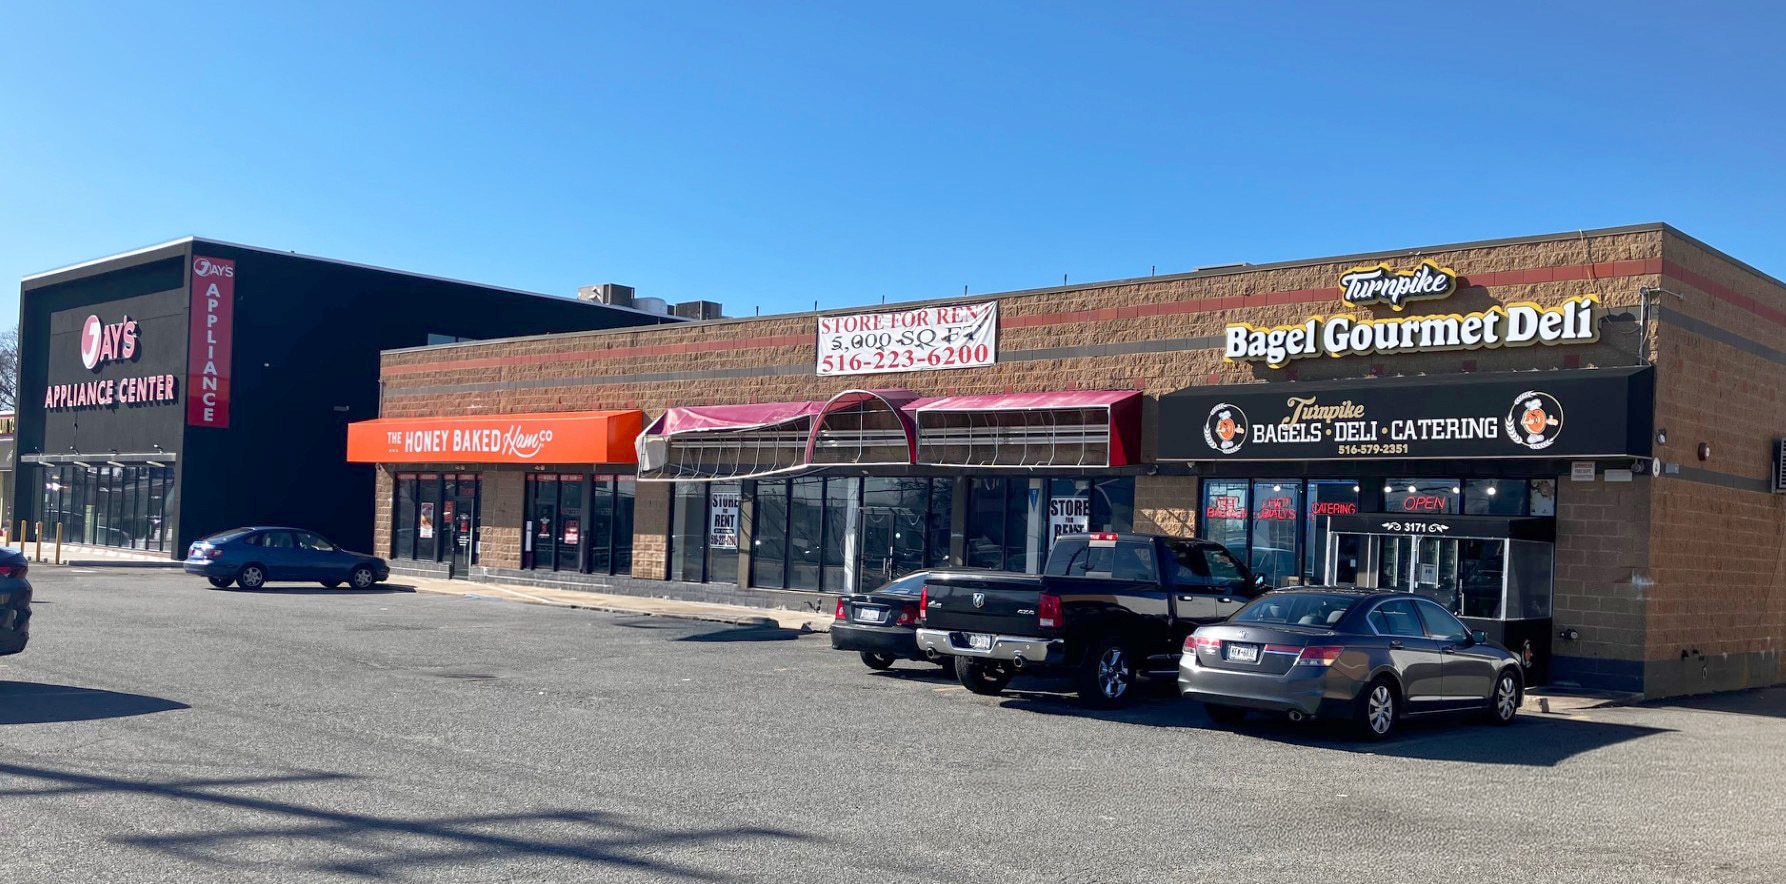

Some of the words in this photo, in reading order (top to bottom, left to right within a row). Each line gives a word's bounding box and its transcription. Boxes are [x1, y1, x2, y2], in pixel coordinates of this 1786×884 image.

[1341, 263, 1449, 304] Turnpike
[821, 315, 884, 334] STORE
[891, 308, 930, 329] FOR
[1225, 318, 1317, 364] Bagel
[1322, 309, 1499, 354] Gourmet
[1505, 297, 1594, 344] Deli
[202, 283, 220, 422] APPLIANCE
[822, 343, 988, 373] 516-223-6200
[44, 381, 114, 408] APPLIANCE
[118, 374, 175, 404] CENTER
[1282, 396, 1366, 431] Turnpike
[387, 432, 402, 444] THE
[405, 430, 449, 453] HONEY
[453, 429, 501, 453] BAKED
[501, 424, 544, 459] Ham
[1252, 422, 1322, 443] BAGELS
[1334, 421, 1378, 442] DELI
[1391, 417, 1498, 441] CATERING
[1338, 443, 1408, 455] 516-579-2351
[712, 494, 738, 508] STORE
[1050, 500, 1089, 516] STORE
[1312, 502, 1356, 515] CATERING
[1404, 496, 1445, 511] OPEN
[714, 514, 735, 528] RENT
[1054, 524, 1084, 536] RENT
[1404, 523, 1427, 532] 3171
